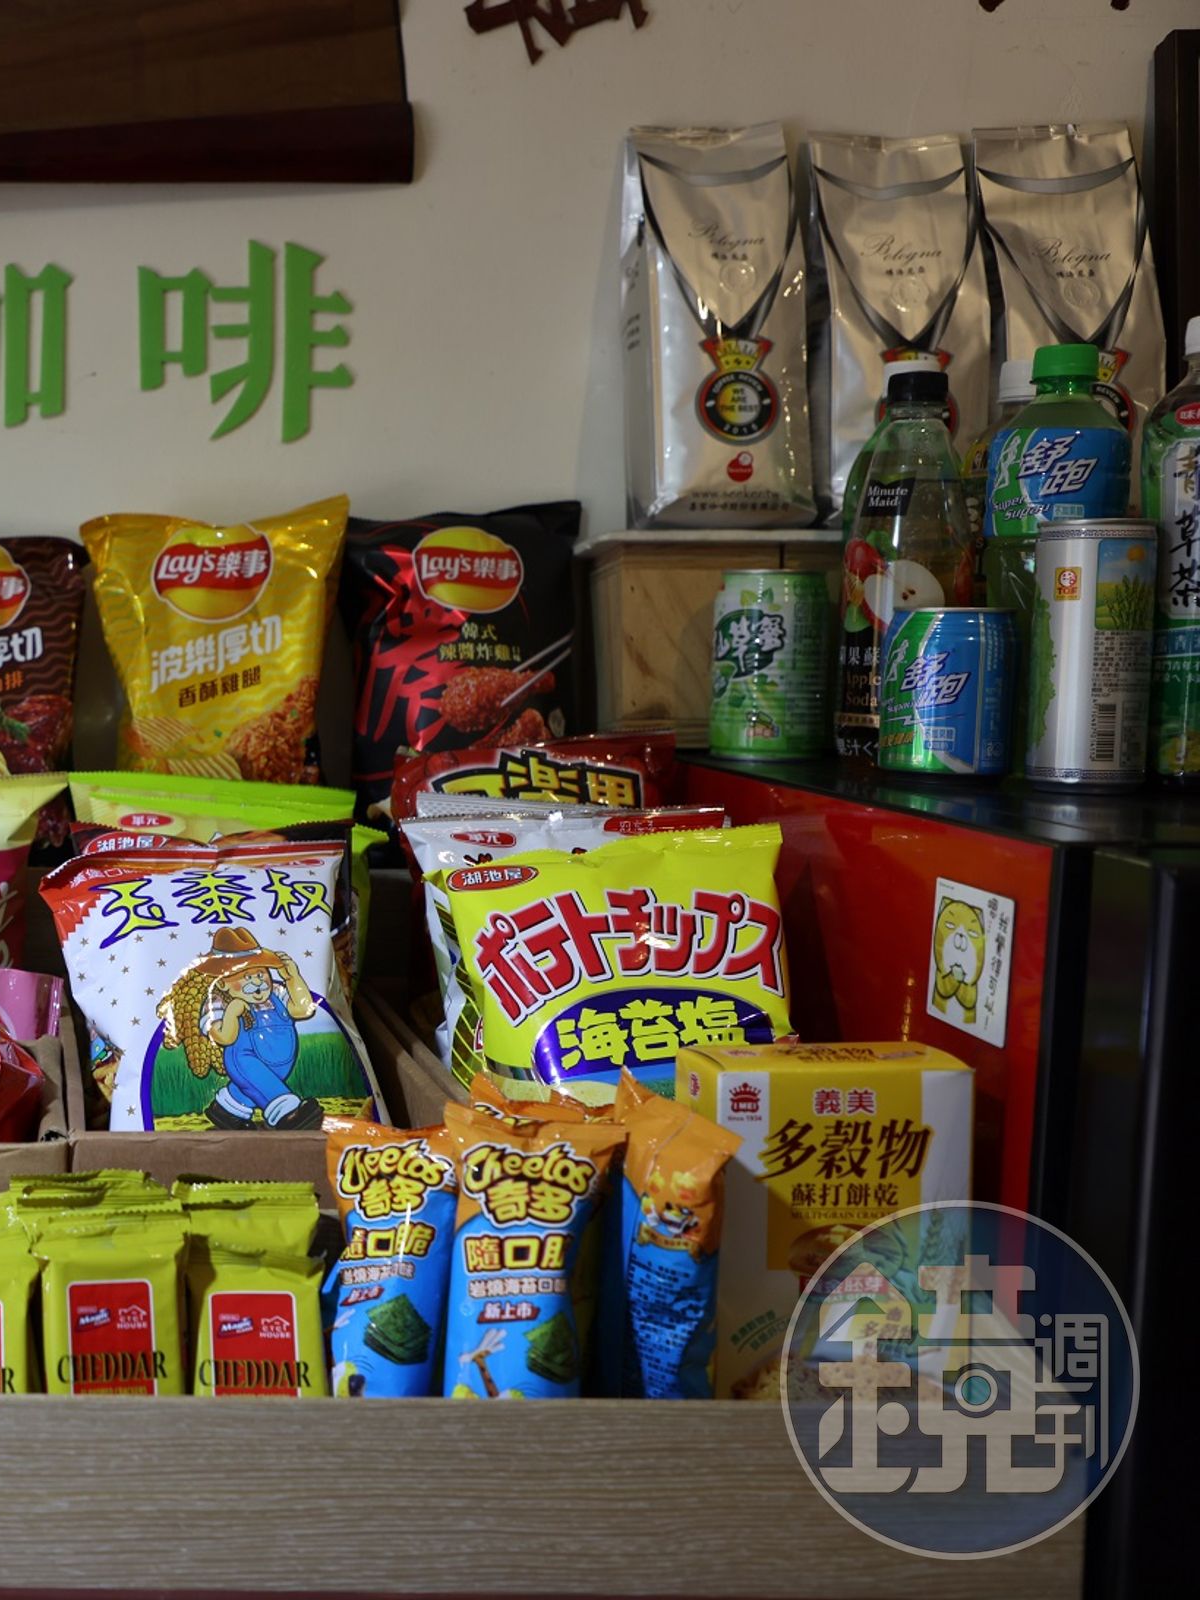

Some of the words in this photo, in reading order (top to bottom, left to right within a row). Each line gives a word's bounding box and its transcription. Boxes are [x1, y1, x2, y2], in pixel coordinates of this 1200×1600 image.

[688, 222, 765, 249] Bologna
[860, 234, 942, 264] Bologna
[1032, 238, 1112, 265] Bologna
[1180, 408, 1200, 420] 味
[1017, 434, 1098, 498] 舒跑
[867, 485, 909, 498] Minute
[868, 495, 900, 508] Maid
[150, 615, 283, 693] 波樂厚切
[179, 665, 261, 708] 香酥雞腿
[901, 651, 971, 709] 舒跑
[97, 836, 154, 850] 湖池屋
[462, 867, 524, 885] 湖池屋
[474, 887, 785, 1027] ポテトチップス
[558, 996, 746, 1071] 海苔塩
[815, 1090, 875, 1114] 義美
[341, 1139, 445, 1194] Cheetos
[754, 1119, 934, 1183] 多穀物
[464, 1145, 595, 1193] Cheetos
[361, 1175, 425, 1217] 奇多
[487, 1179, 573, 1221] 奇多
[792, 1183, 899, 1208] 蘇打餅乾
[485, 1303, 533, 1320] 新上市
[58, 1350, 167, 1383] CHEDDAR
[199, 1359, 311, 1388] CHEDDAR
